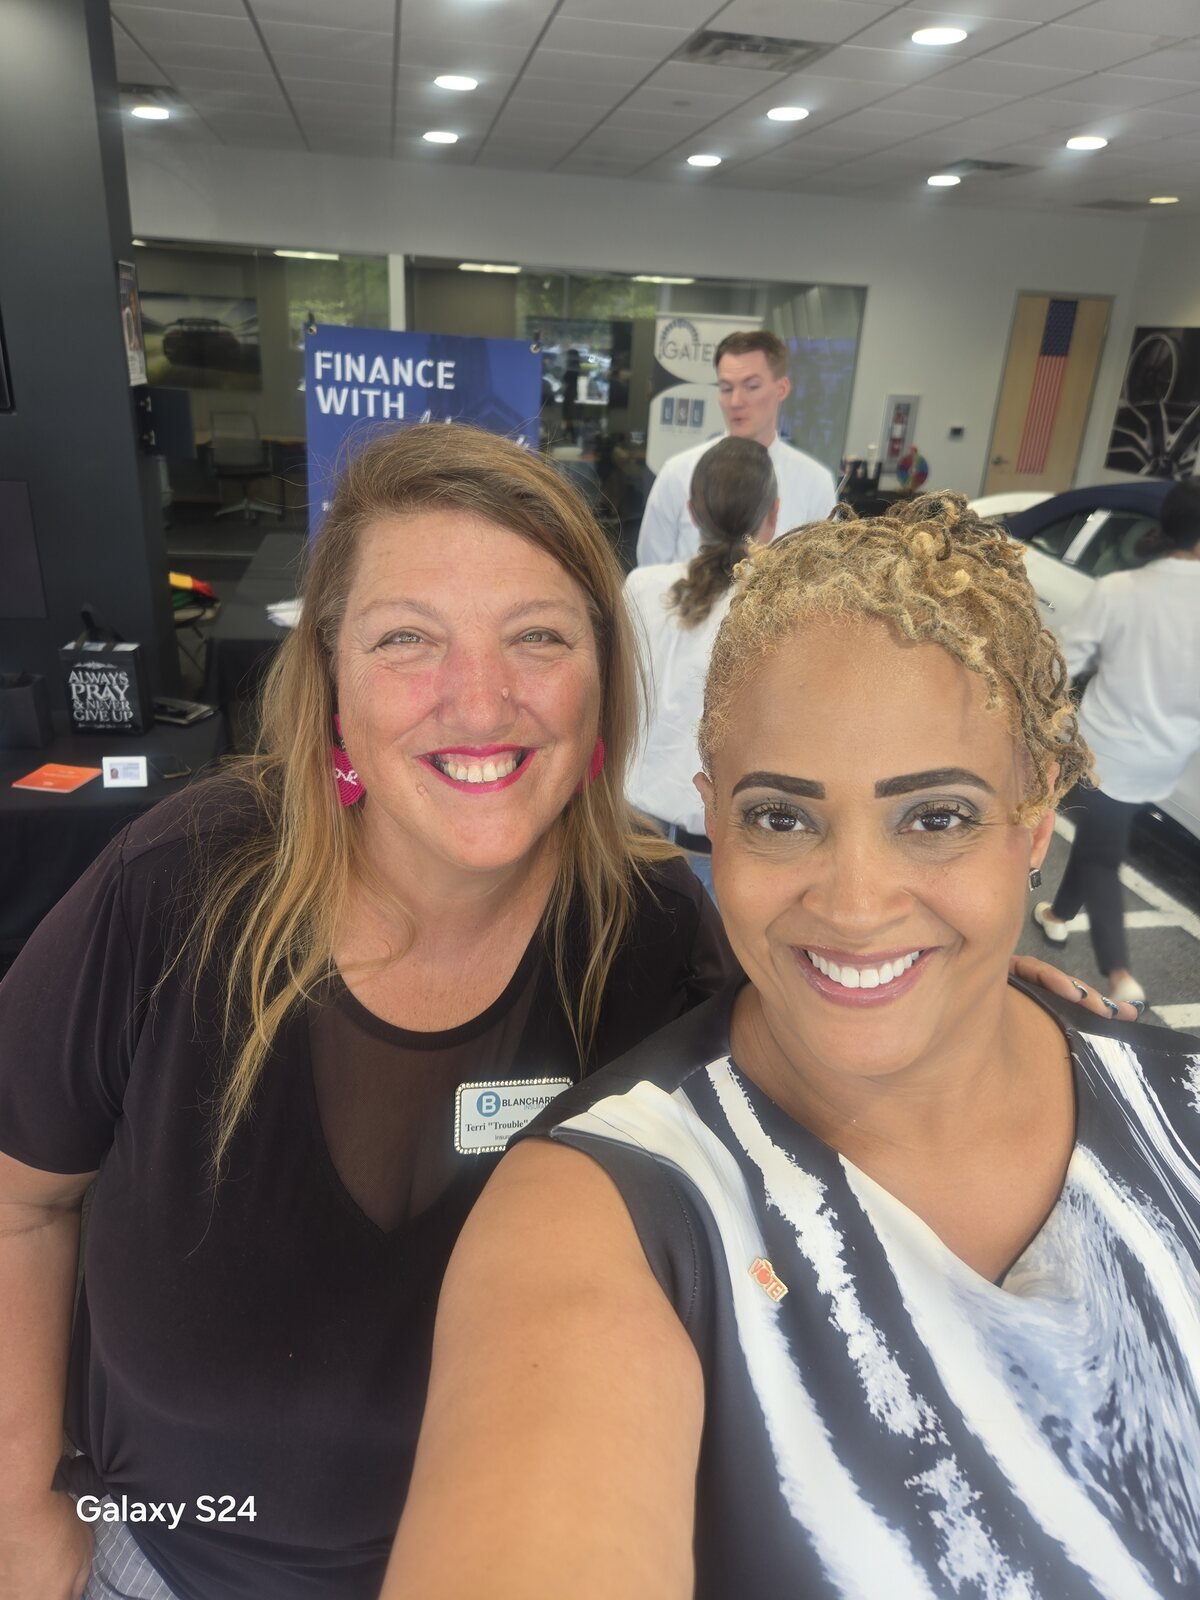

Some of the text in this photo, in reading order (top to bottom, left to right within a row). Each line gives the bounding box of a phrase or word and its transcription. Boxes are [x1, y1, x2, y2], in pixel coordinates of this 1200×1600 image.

[663, 341, 716, 362] GATE
[315, 351, 456, 390] FINANCE
[315, 386, 405, 419] WITH
[69, 671, 129, 686] ALWAYS
[71, 684, 129, 701] PRAY
[74, 699, 131, 711] & NEVER
[73, 710, 134, 722] GIVE UP
[465, 1119, 528, 1132] Terri "Trouble"
